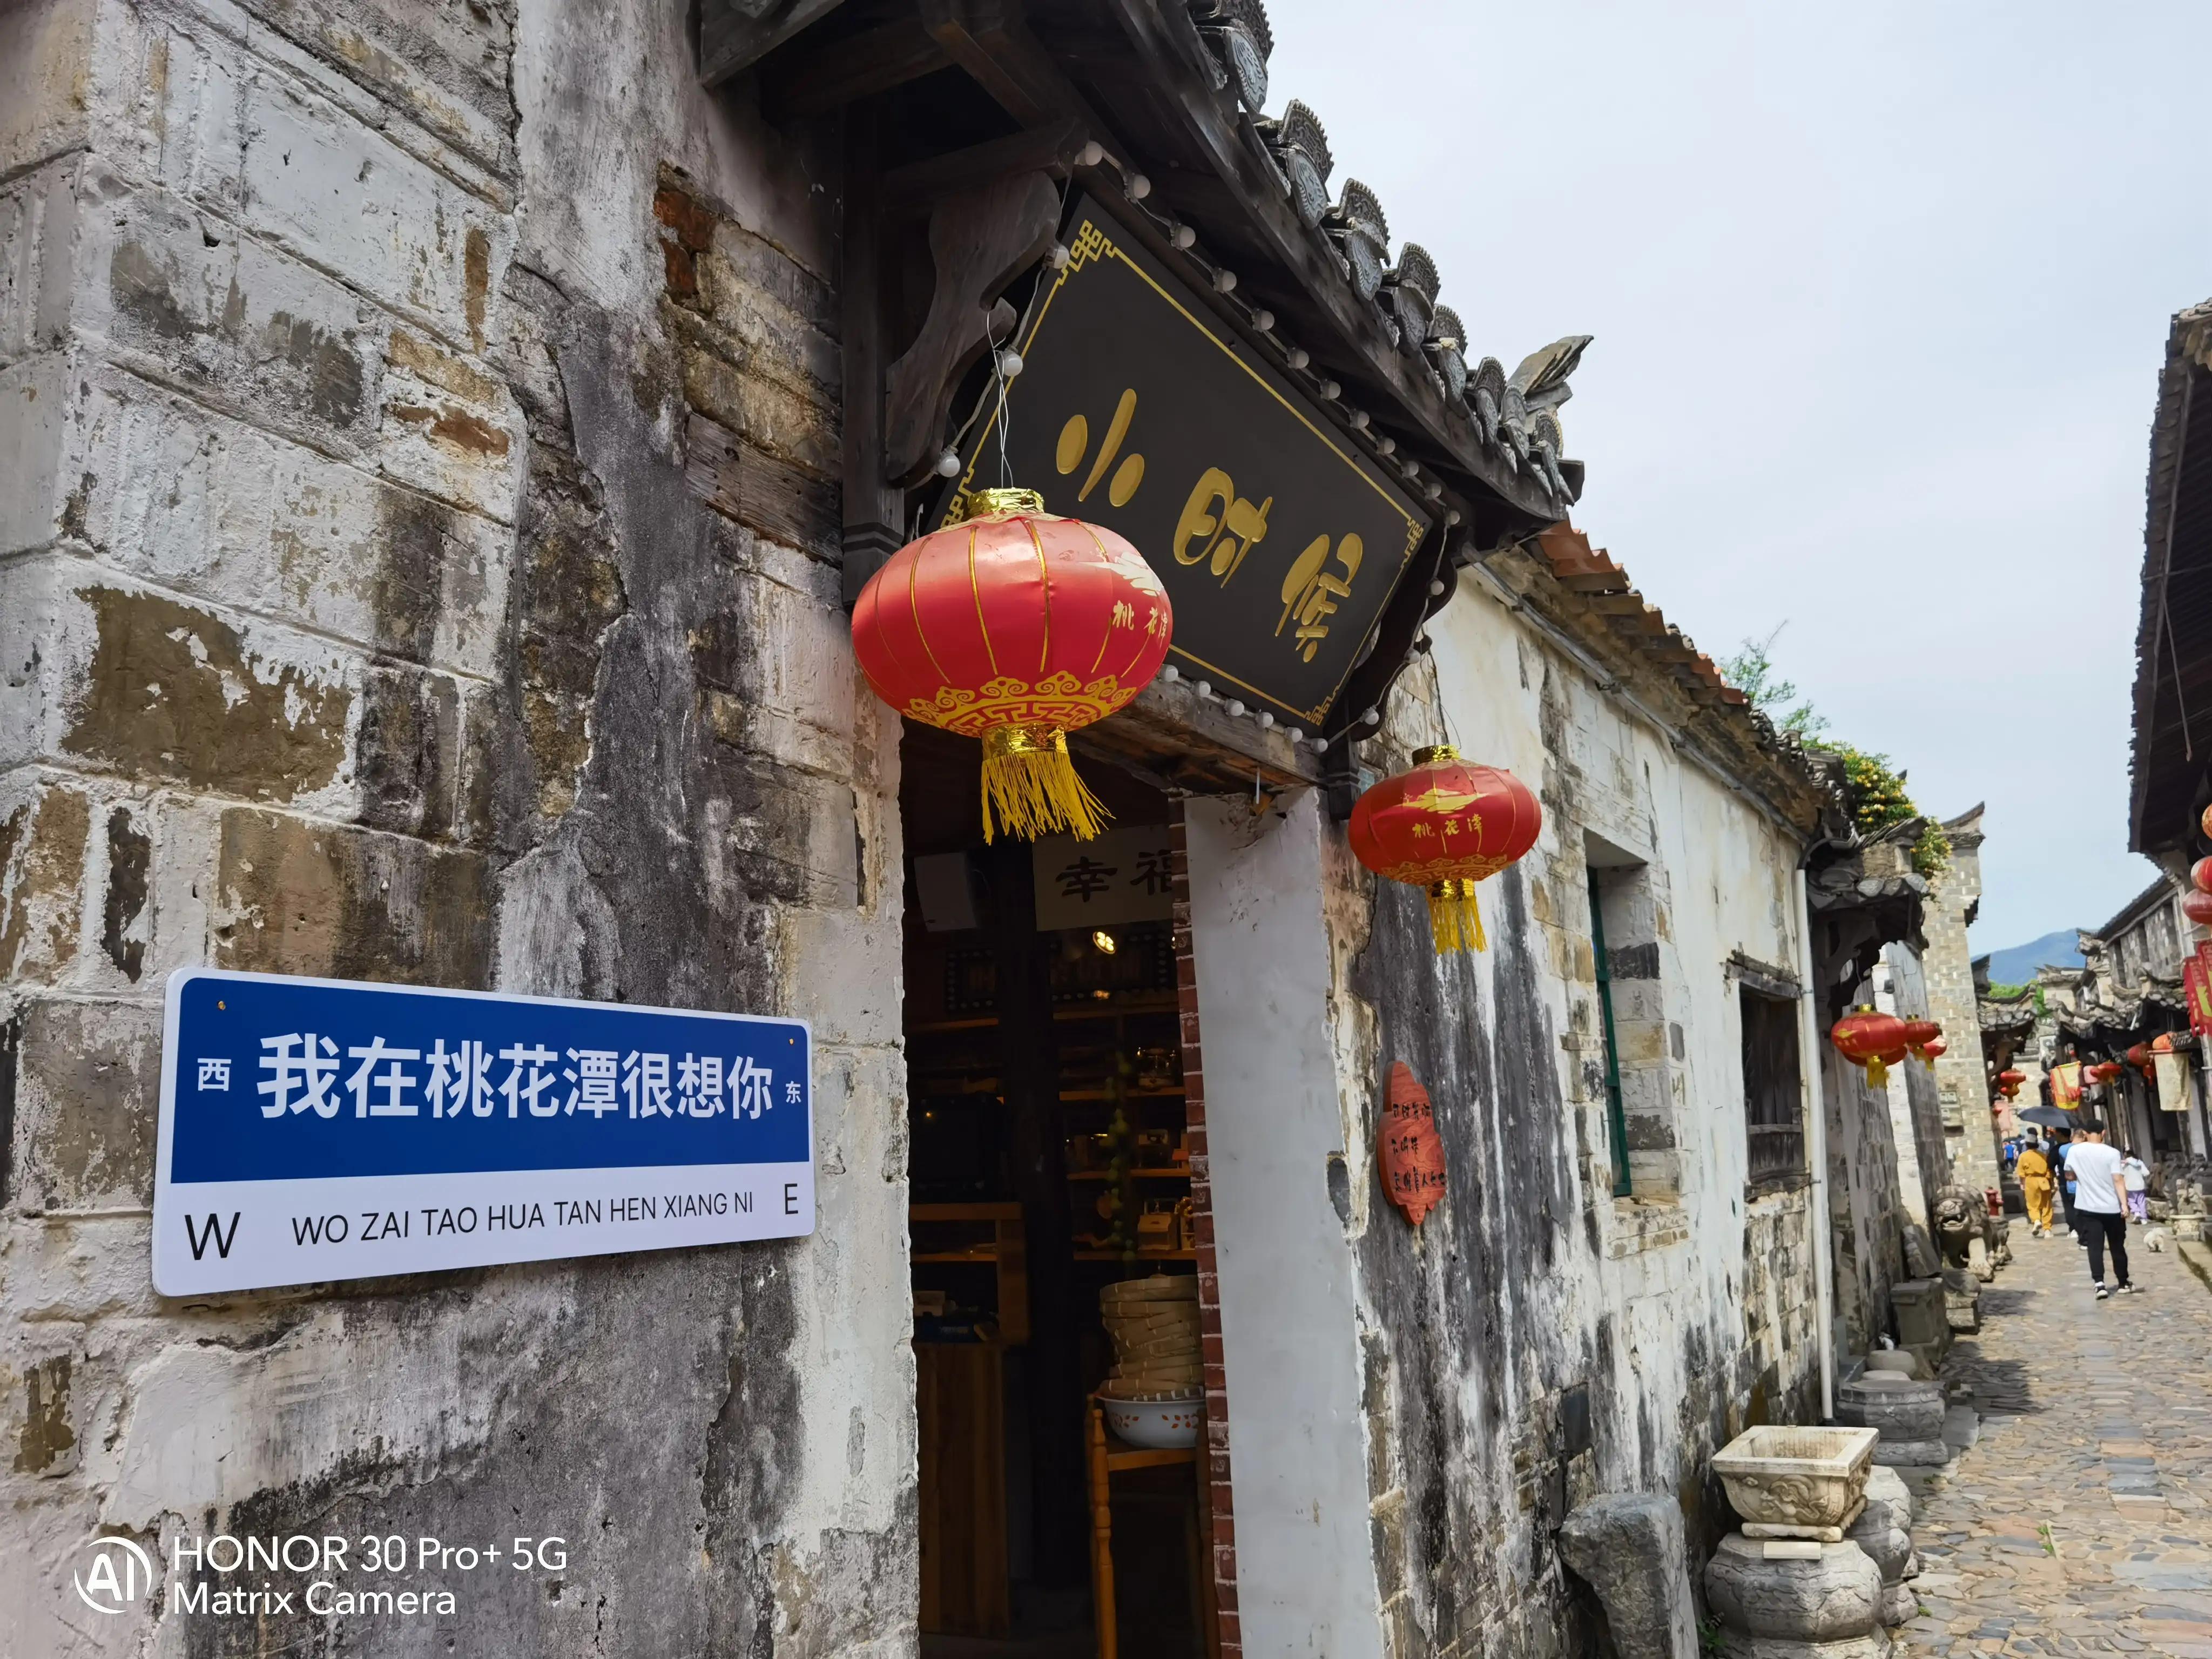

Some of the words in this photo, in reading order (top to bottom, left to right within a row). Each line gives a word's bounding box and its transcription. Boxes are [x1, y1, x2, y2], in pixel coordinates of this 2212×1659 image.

[1055, 388, 1364, 663] 小时候
[1412, 813, 1483, 838] 桃花潭
[197, 1057, 232, 1091] 西
[257, 1032, 773, 1120] 我在桃花潭很想你
[785, 1080, 802, 1105] 东
[292, 1215, 348, 1246] WO
[361, 1210, 409, 1241] ZAI
[421, 1206, 477, 1236] TAO
[488, 1203, 545, 1231] HUA
[554, 1199, 601, 1225] TAN
[610, 1197, 656, 1222] HEN
[664, 1192, 727, 1218] XIANG
[734, 1191, 753, 1213] NI
[784, 1183, 799, 1215] E
[184, 1212, 241, 1260] W
